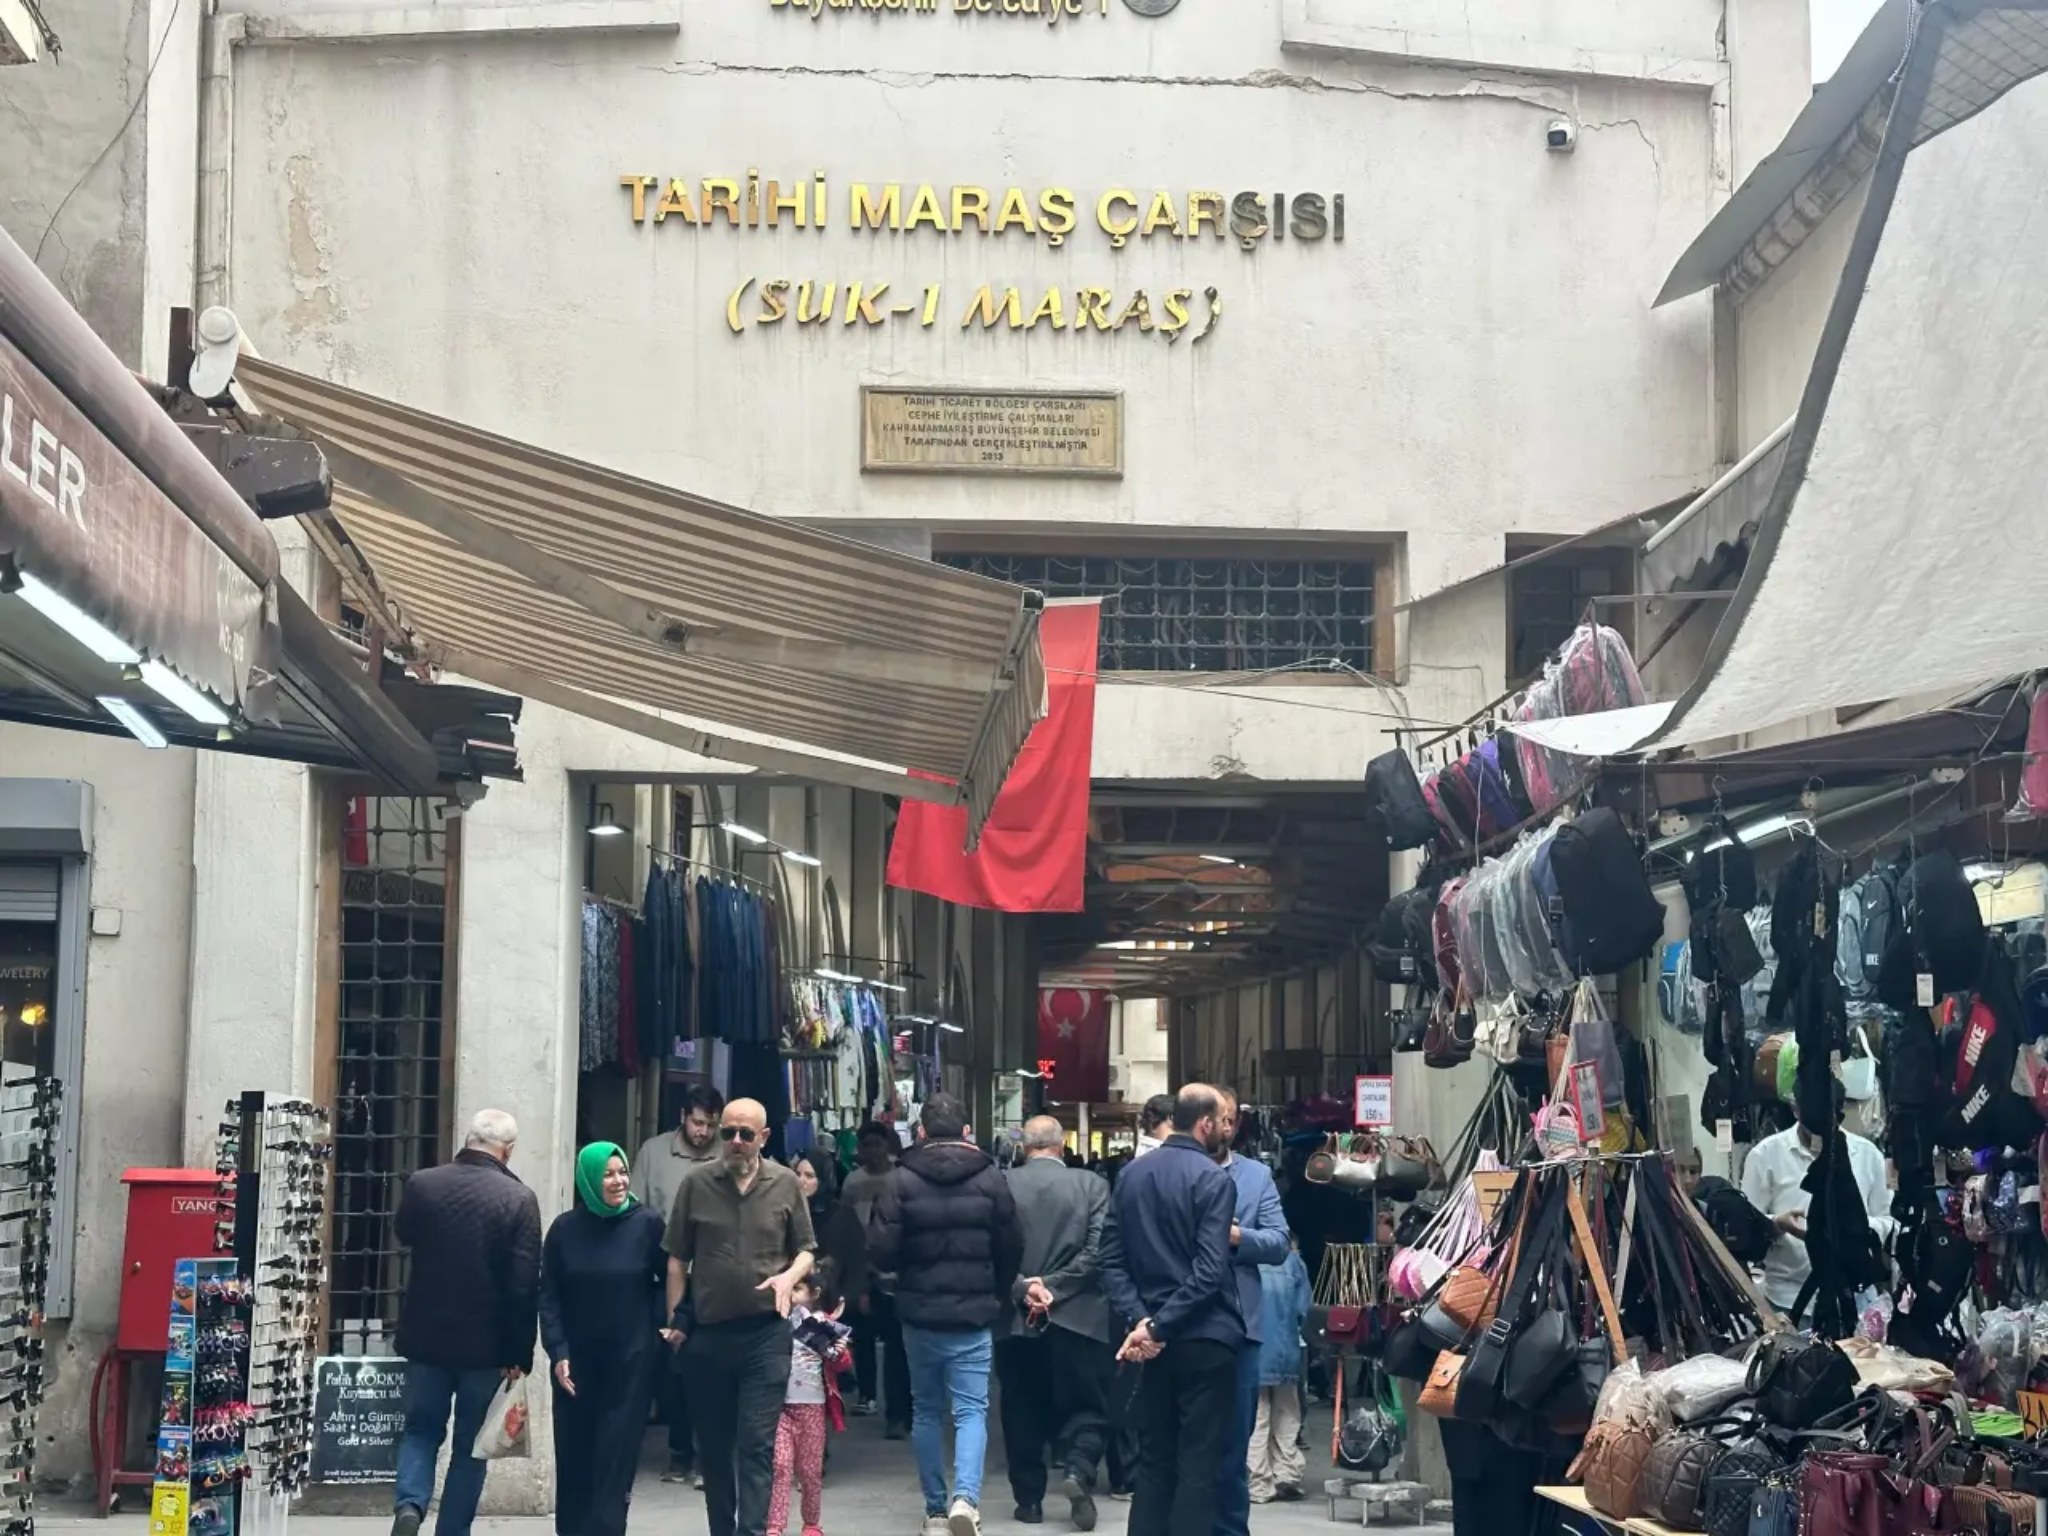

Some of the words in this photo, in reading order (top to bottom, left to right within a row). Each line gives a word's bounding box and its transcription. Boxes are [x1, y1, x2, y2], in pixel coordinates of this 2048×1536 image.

[619, 167, 828, 229] TARİHİ
[850, 183, 1077, 248] MARAŞ
[1096, 188, 1346, 251] ÇARŞISI
[961, 284, 1223, 344] MARAŞ)
[908, 410, 941, 420] CEPHE
[904, 436, 968, 447] TARAFINDAN
[1, 393, 88, 533] LER
[1964, 1023, 1987, 1067] NIKE
[1961, 1084, 1991, 1124] NIKE
[355, 1372, 406, 1387] KORKM
[323, 1422, 347, 1433] Saat
[359, 1422, 391, 1434] Doğal
[337, 1436, 359, 1446] Gold
[368, 1436, 394, 1446] Silver
